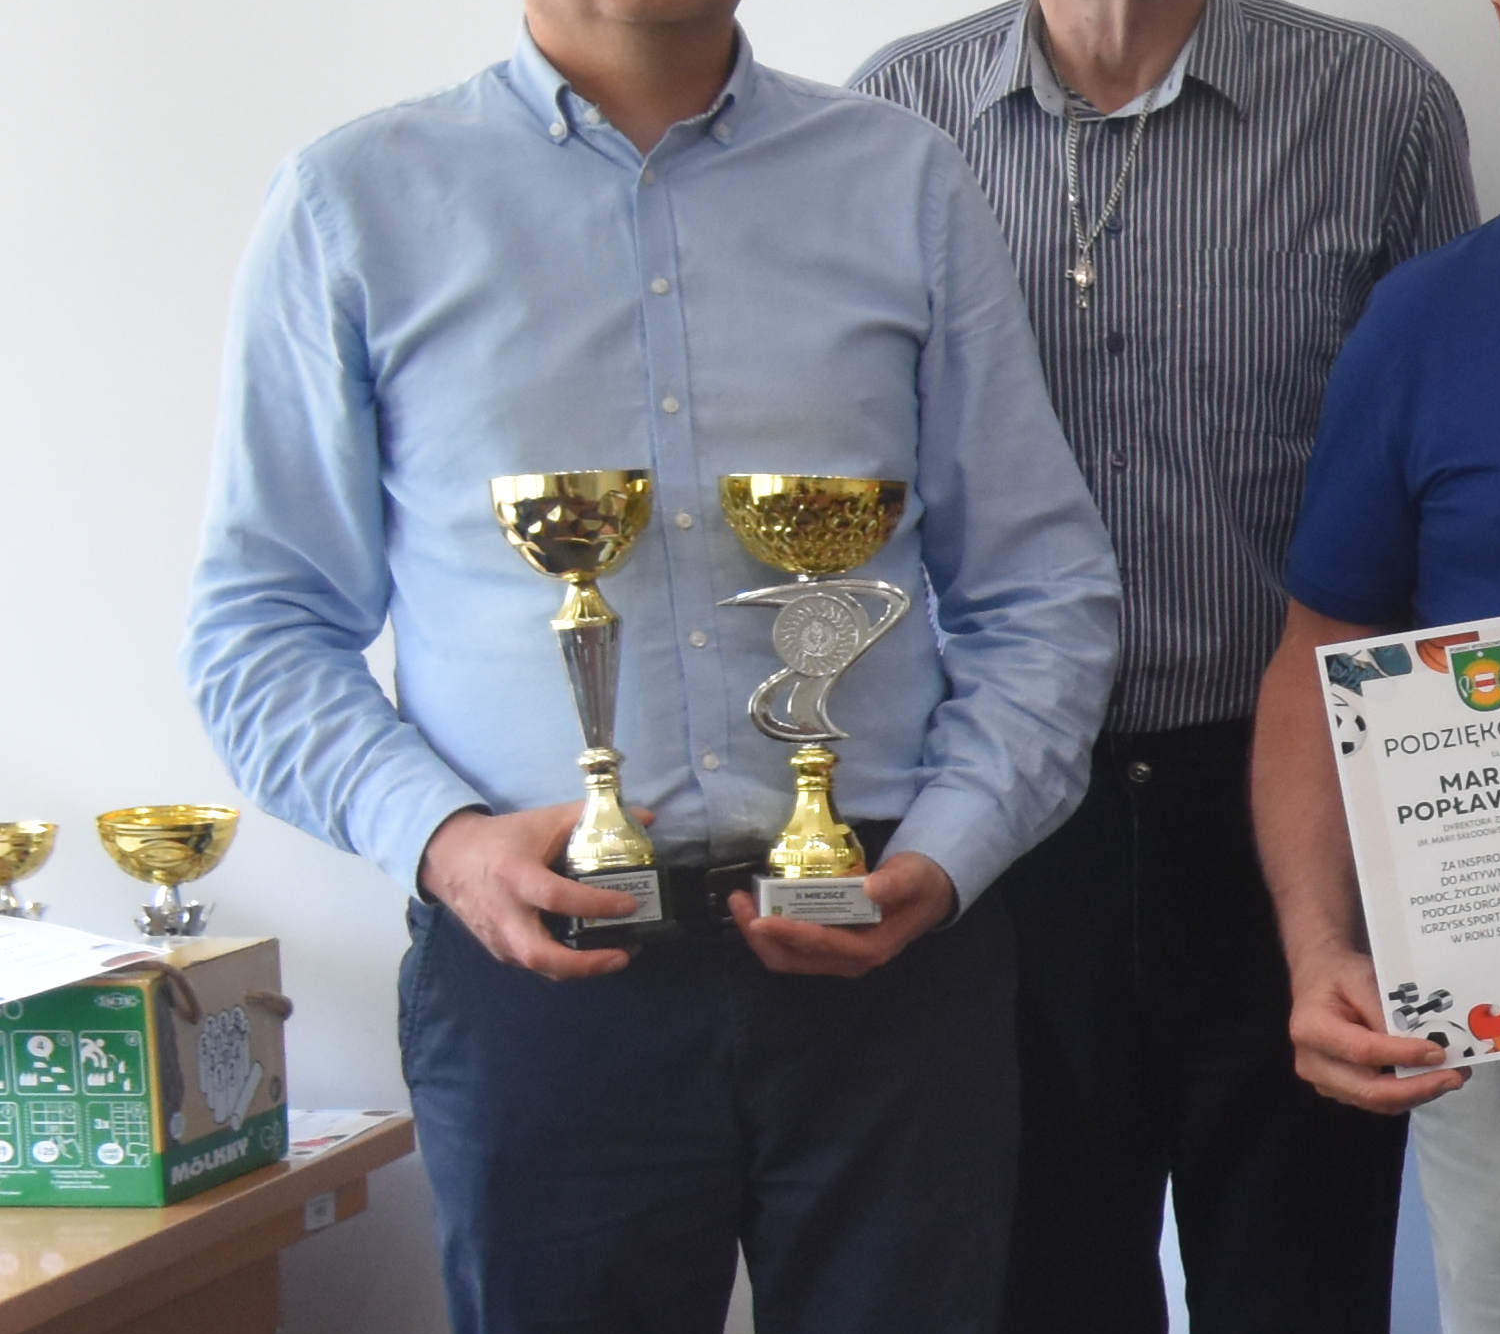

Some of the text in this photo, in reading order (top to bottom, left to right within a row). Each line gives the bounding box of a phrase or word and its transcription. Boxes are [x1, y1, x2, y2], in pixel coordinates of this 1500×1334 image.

[1441, 861, 1457, 872] ZA
[1440, 876, 1458, 887] DO
[1422, 903, 1473, 919] PODCZAS
[1420, 919, 1467, 935] IGRZYSK
[1451, 934, 1464, 944] W
[1465, 928, 1495, 942] ROKU
